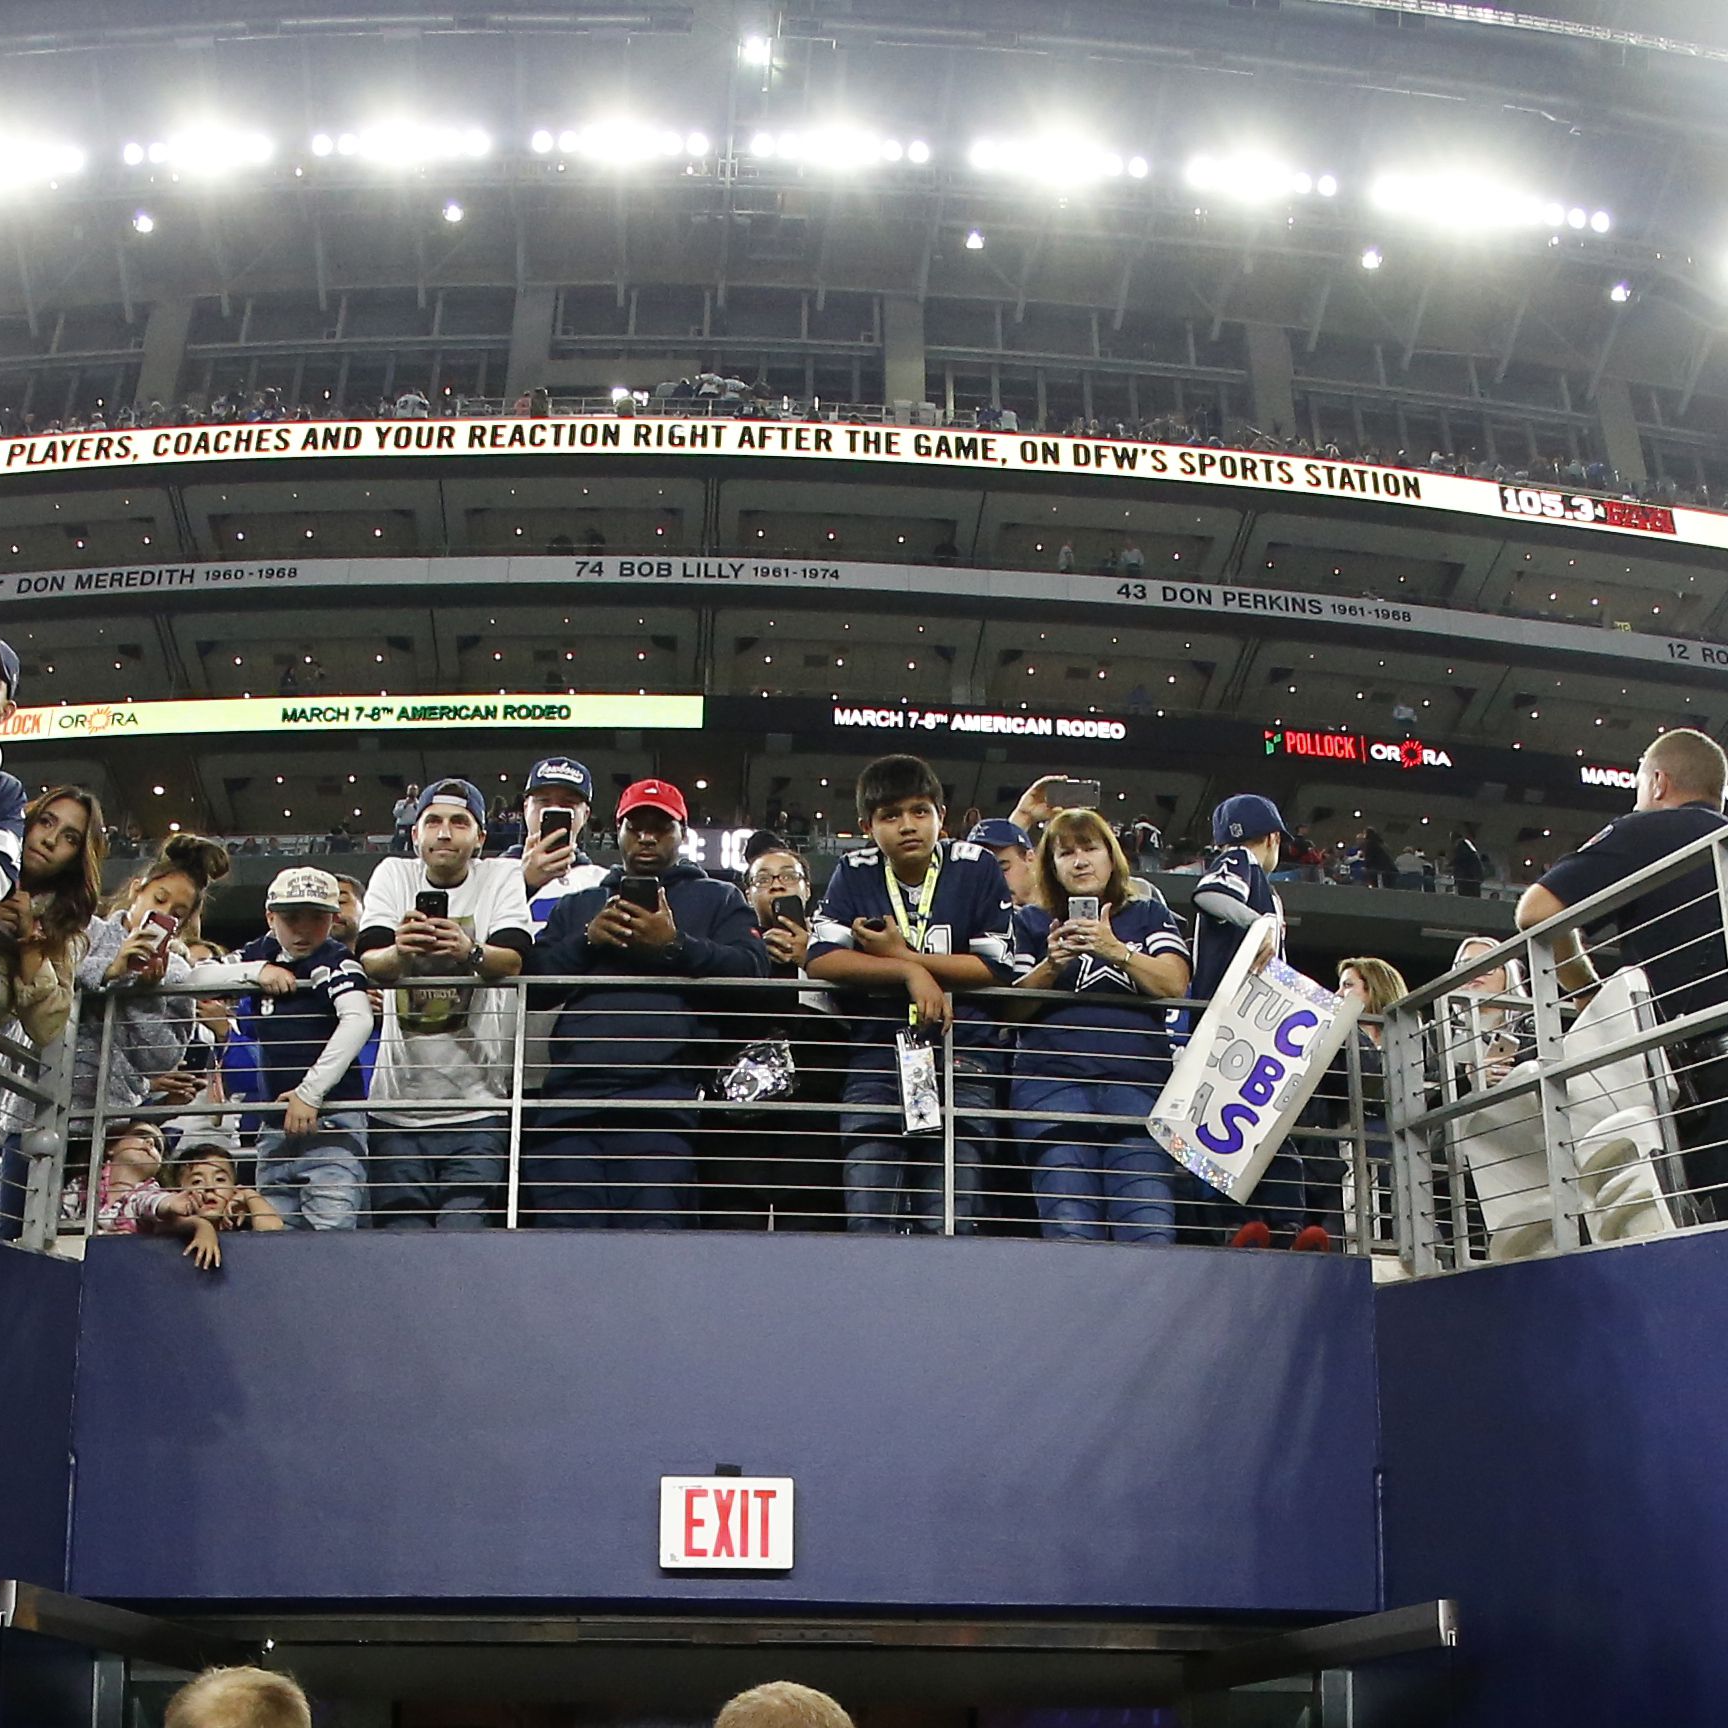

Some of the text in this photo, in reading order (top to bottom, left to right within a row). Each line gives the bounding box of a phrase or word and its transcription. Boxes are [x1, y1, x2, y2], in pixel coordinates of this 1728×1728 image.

[6, 423, 1421, 499] PLAYERS, COACHES AND YOUR REACTION RIGHT AFTER THE GAME, ON DFW'S SPORTS STATION
[1503, 488, 1596, 522] 105.3
[16, 576, 65, 595] DON
[74, 568, 195, 592] MEREDITH
[574, 561, 841, 581] 74 BOB LILLY 1961-1974
[1117, 583, 1412, 623] 43 DON PERKINS 1961-1968
[1667, 643, 1690, 660] 12
[281, 707, 349, 724] MARCH
[397, 704, 498, 722] AMERICAN
[503, 704, 571, 721] RODEO
[834, 706, 904, 728] MARCH
[950, 712, 1052, 735] AMERICAN
[1056, 720, 1126, 740] RODEO
[1286, 731, 1356, 759] POLLOCK
[684, 1488, 777, 1558] EXIT
